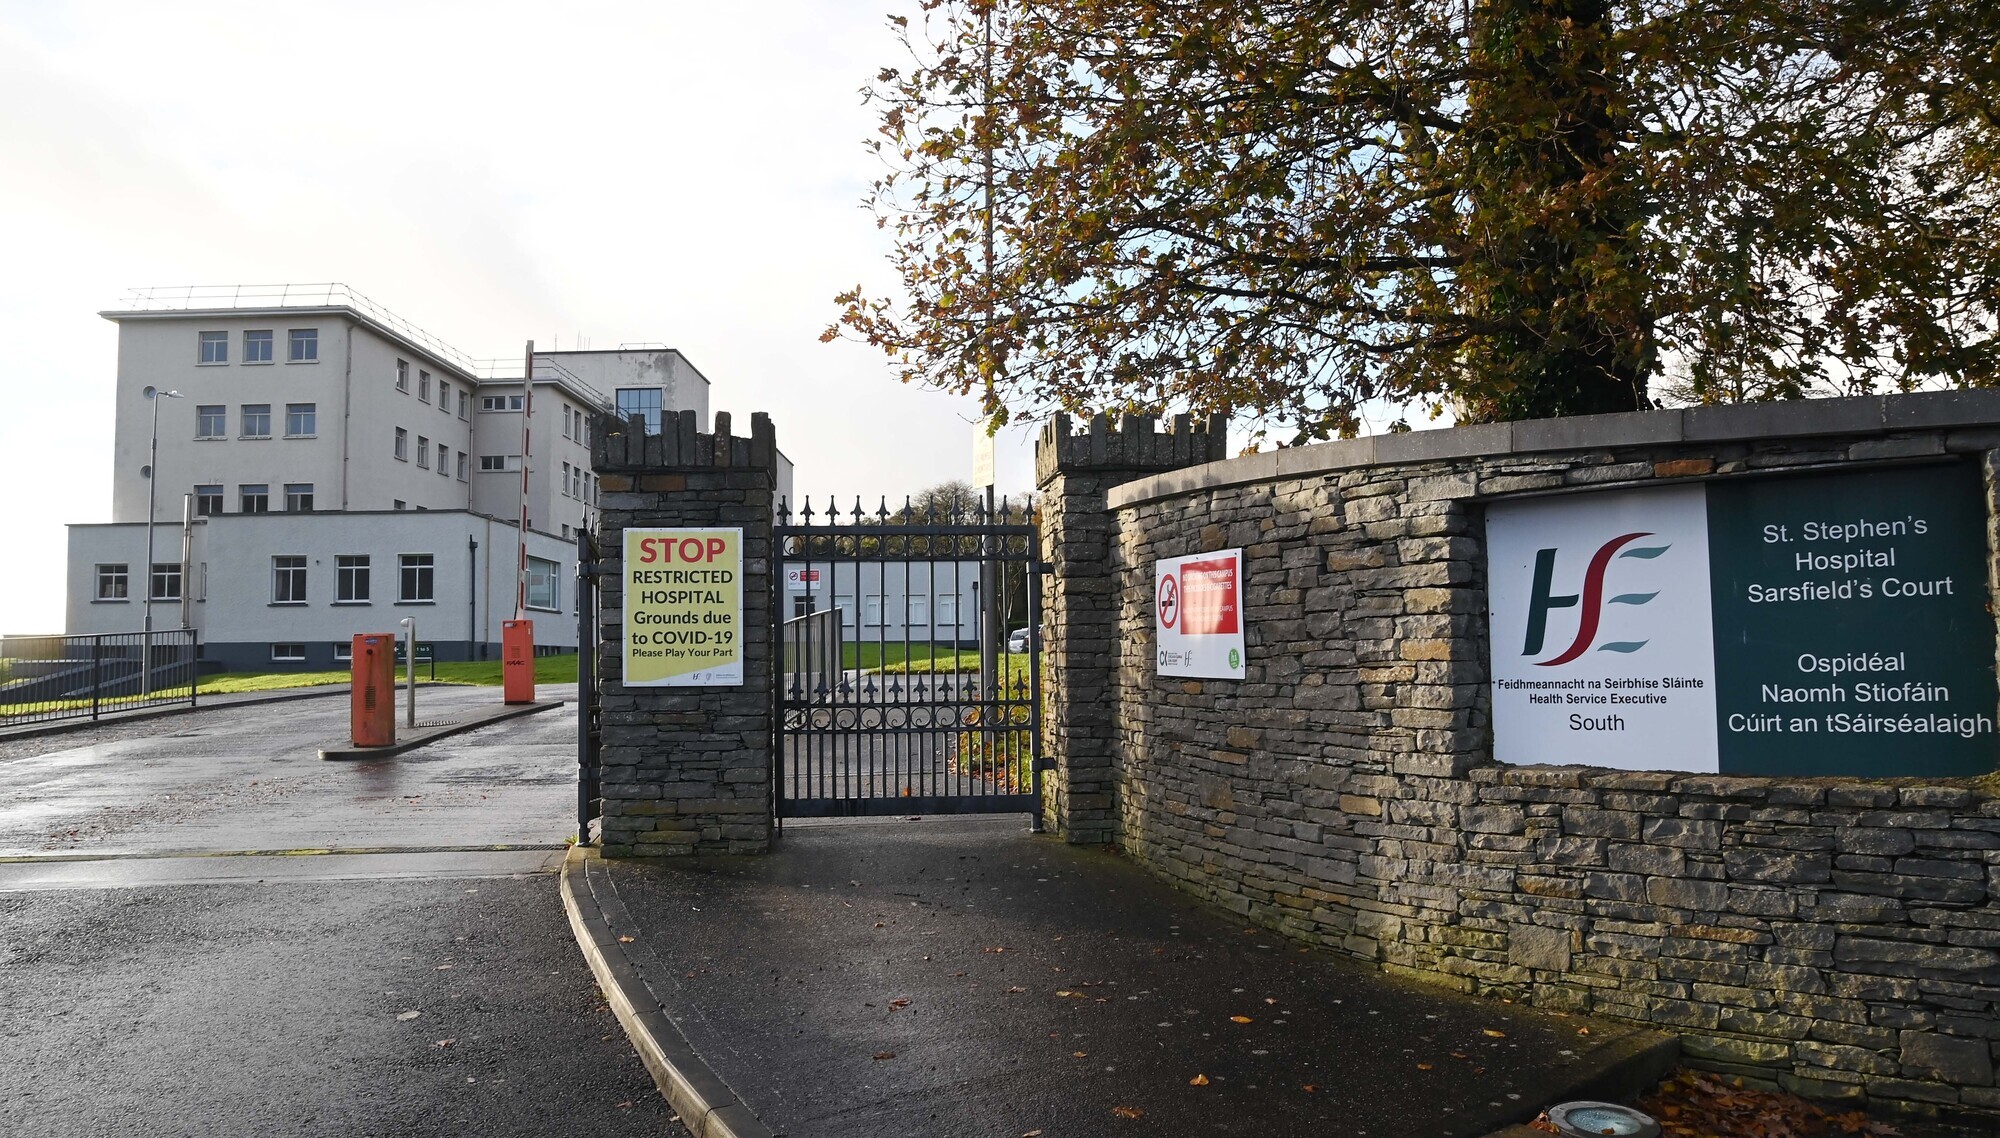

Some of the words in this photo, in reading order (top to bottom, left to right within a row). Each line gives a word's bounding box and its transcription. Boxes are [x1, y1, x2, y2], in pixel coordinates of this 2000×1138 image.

[1763, 524, 1794, 544] St.
[1803, 516, 1928, 543] Stephen's
[639, 538, 726, 564] STOP
[1795, 548, 1896, 573] Hospital
[633, 570, 733, 584] RESTRICTED
[641, 590, 725, 604] HOSPITAL
[1748, 580, 1873, 603] Sarsfield's
[1881, 576, 1954, 598] Court
[1520, 532, 1673, 667] HSE
[634, 611, 699, 625] Grounds
[703, 611, 731, 625] due
[632, 631, 648, 645] to
[652, 631, 733, 645] COVID-19
[632, 648, 663, 657] Please
[665, 648, 686, 659] Play
[688, 648, 711, 657] Your
[713, 648, 733, 657] Part
[1797, 652, 1905, 676] Ospidéal
[1497, 678, 1585, 690] Feidhmeannacht
[1588, 680, 1601, 689] na
[1604, 678, 1659, 689] Seirbhíse
[1662, 677, 1704, 689] Sláinte
[1761, 683, 1845, 703] Naomh
[1854, 682, 1949, 702] Stiofáin
[1529, 693, 1563, 704] Health
[1566, 693, 1607, 704] Service
[1610, 693, 1667, 704] Executive
[1569, 713, 1625, 731] South
[1728, 713, 1782, 733] Cúirt
[1789, 716, 1818, 733] an
[1826, 713, 1992, 738] tSáirséalaigh
